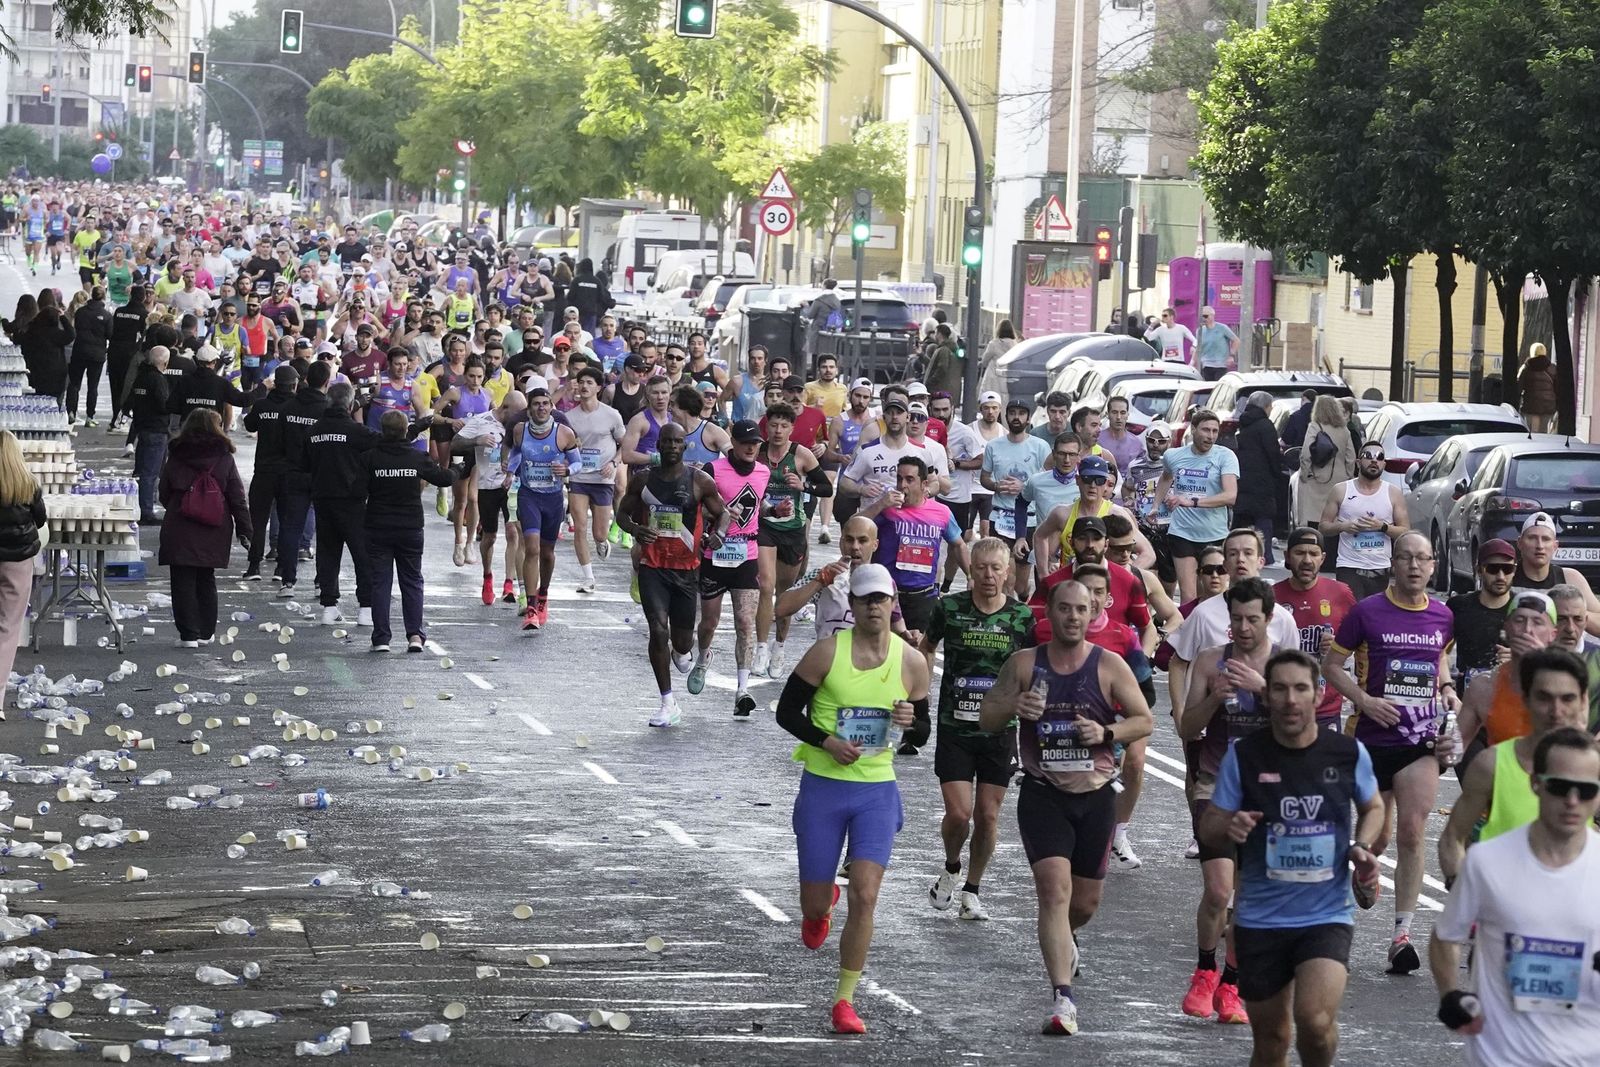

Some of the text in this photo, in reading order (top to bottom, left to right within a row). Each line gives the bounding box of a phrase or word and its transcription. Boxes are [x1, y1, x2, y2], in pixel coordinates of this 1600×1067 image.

[767, 212, 787, 224] 30
[116, 312, 140, 320] VOLUNTEER
[186, 398, 216, 406] VOLUNTEER
[310, 433, 347, 443] VOLUNTEER
[375, 468, 417, 478] VOLUNTEER
[1176, 483, 1207, 492] CHRISTIAN
[911, 537, 933, 546] ZURICH
[716, 552, 745, 560] MUTTI25
[1556, 549, 1582, 560] 4249
[962, 632, 1010, 643] ROTTERDAM
[1382, 633, 1435, 646] WellChild
[964, 639, 1008, 649] MARATHON
[1403, 662, 1432, 673] ZURICH
[1384, 683, 1434, 697] MORRISON
[968, 692, 984, 700] 5183
[857, 710, 888, 719] ZURICH
[849, 734, 878, 745] MASE
[1042, 748, 1090, 760] ROBERTO
[1280, 795, 1325, 821] CV
[1289, 823, 1328, 836] ZURICH
[1279, 853, 1325, 868] TOMÁS
[1528, 938, 1576, 955] ZURICH
[1512, 976, 1565, 997] PLEINS
